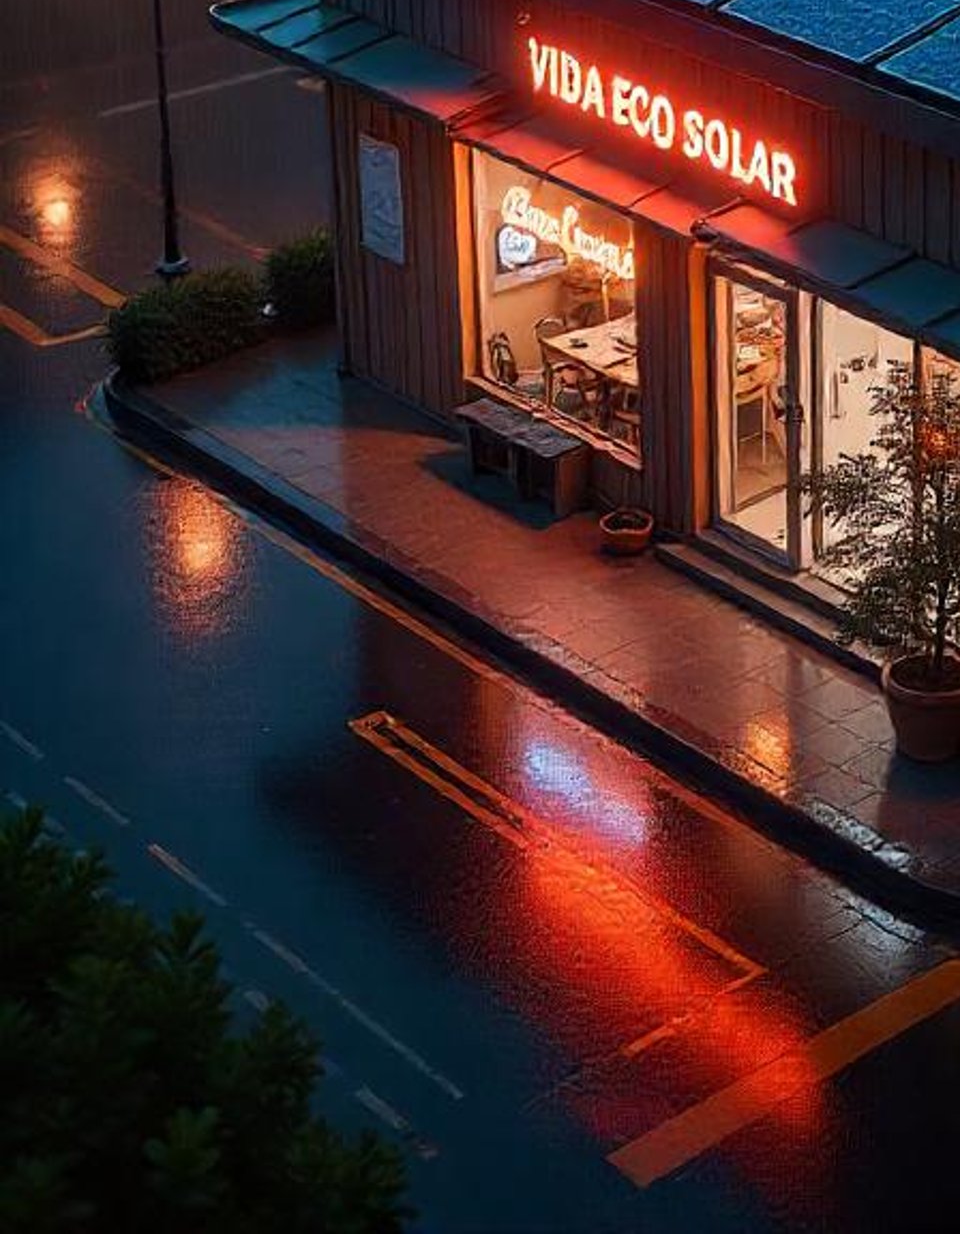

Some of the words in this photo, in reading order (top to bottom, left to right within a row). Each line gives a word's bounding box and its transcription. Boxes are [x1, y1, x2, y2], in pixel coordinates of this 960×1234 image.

[528, 37, 605, 119] VIDA
[611, 75, 676, 150] ECO
[683, 110, 798, 207] SOLAR
